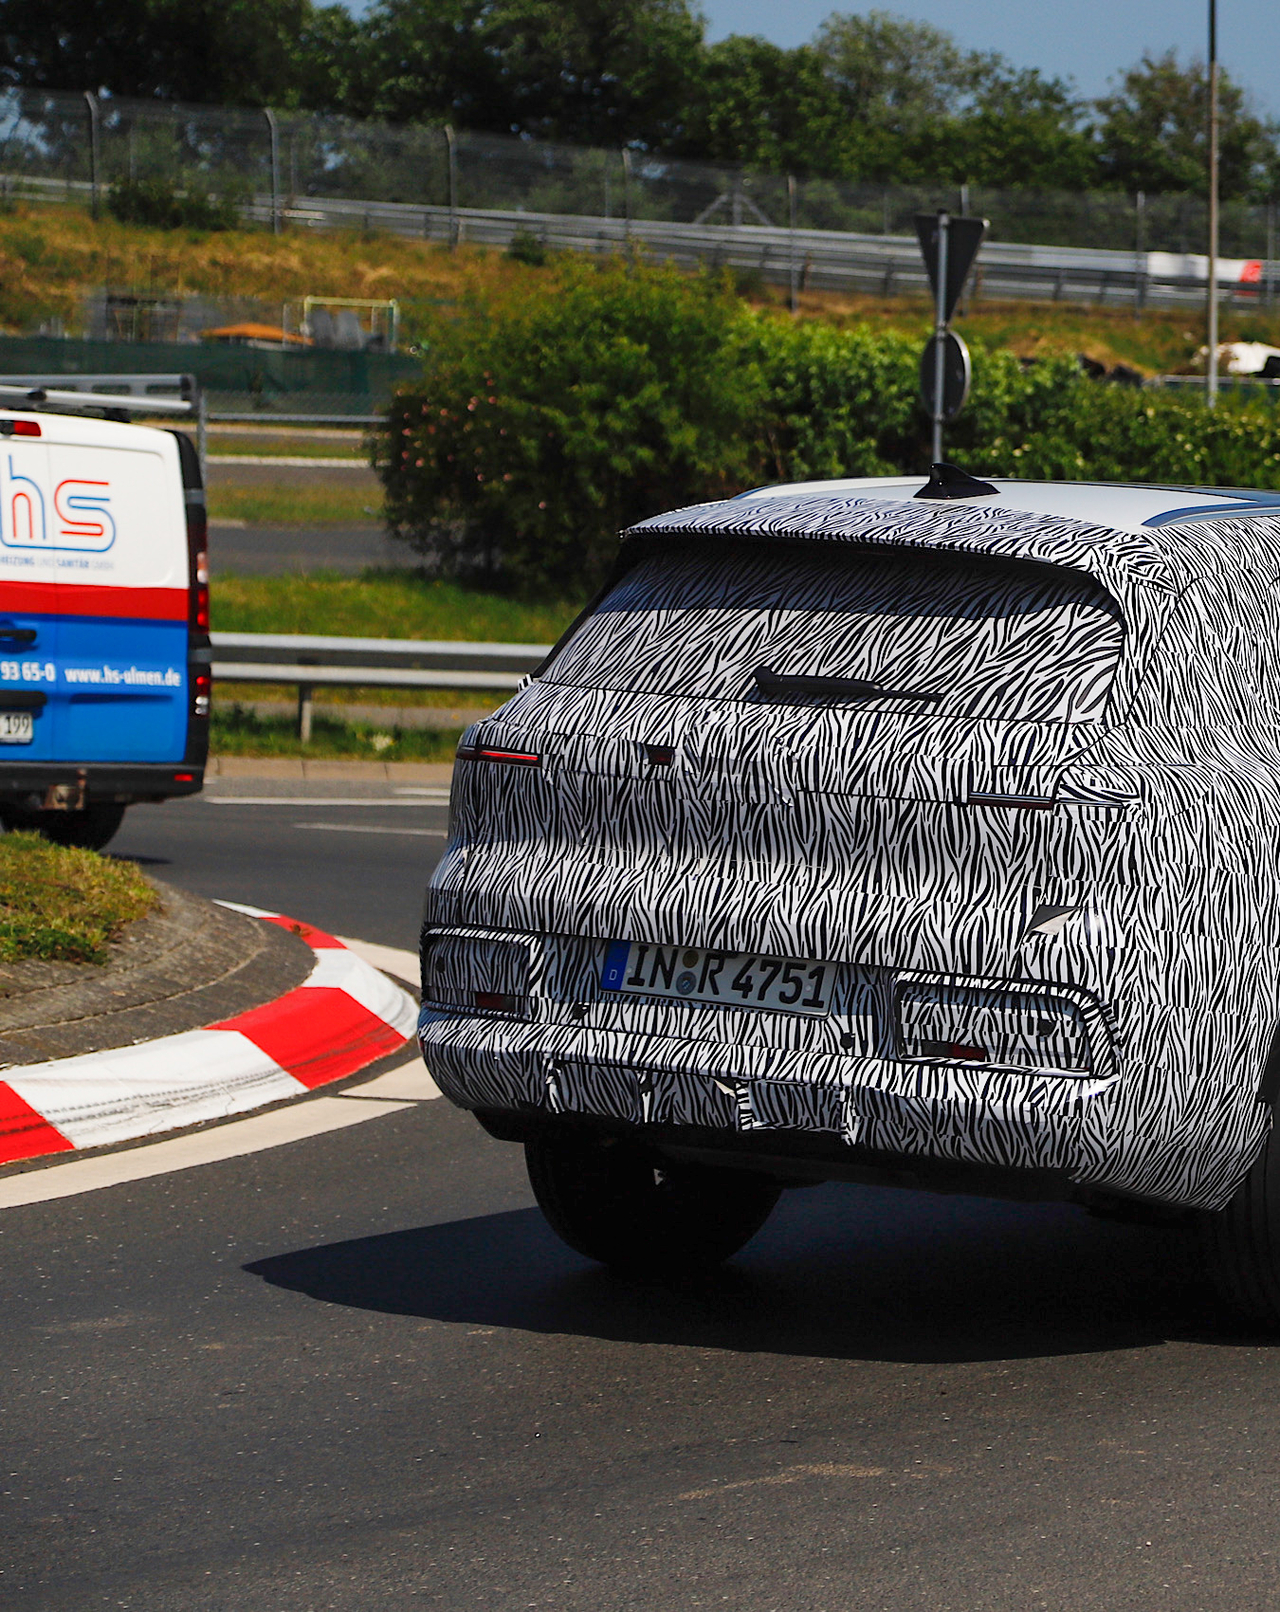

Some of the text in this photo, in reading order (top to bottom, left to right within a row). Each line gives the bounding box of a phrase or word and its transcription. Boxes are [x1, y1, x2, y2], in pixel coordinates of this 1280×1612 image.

[1, 661, 182, 687] 93 65-0 www.hs-ulmen.de
[4, 714, 30, 735] 199
[609, 945, 827, 1009] D IN R 4751
